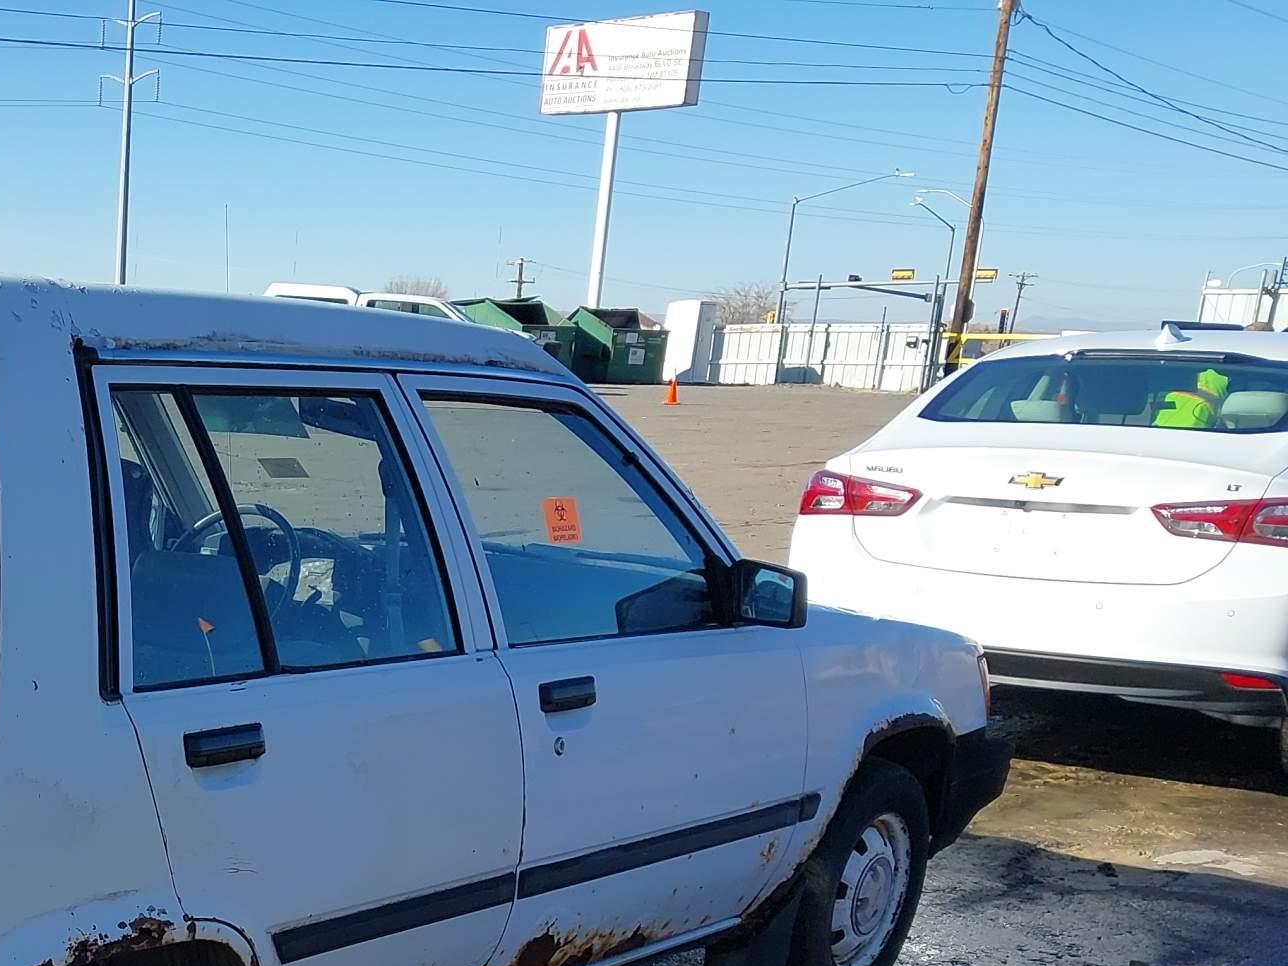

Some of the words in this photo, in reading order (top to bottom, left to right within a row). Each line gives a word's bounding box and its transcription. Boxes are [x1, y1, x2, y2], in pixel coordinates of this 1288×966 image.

[545, 79, 598, 91] INSURANCE
[544, 97, 561, 106] AUTO
[563, 95, 597, 105] AUCTIONS
[1227, 483, 1243, 492] LT
